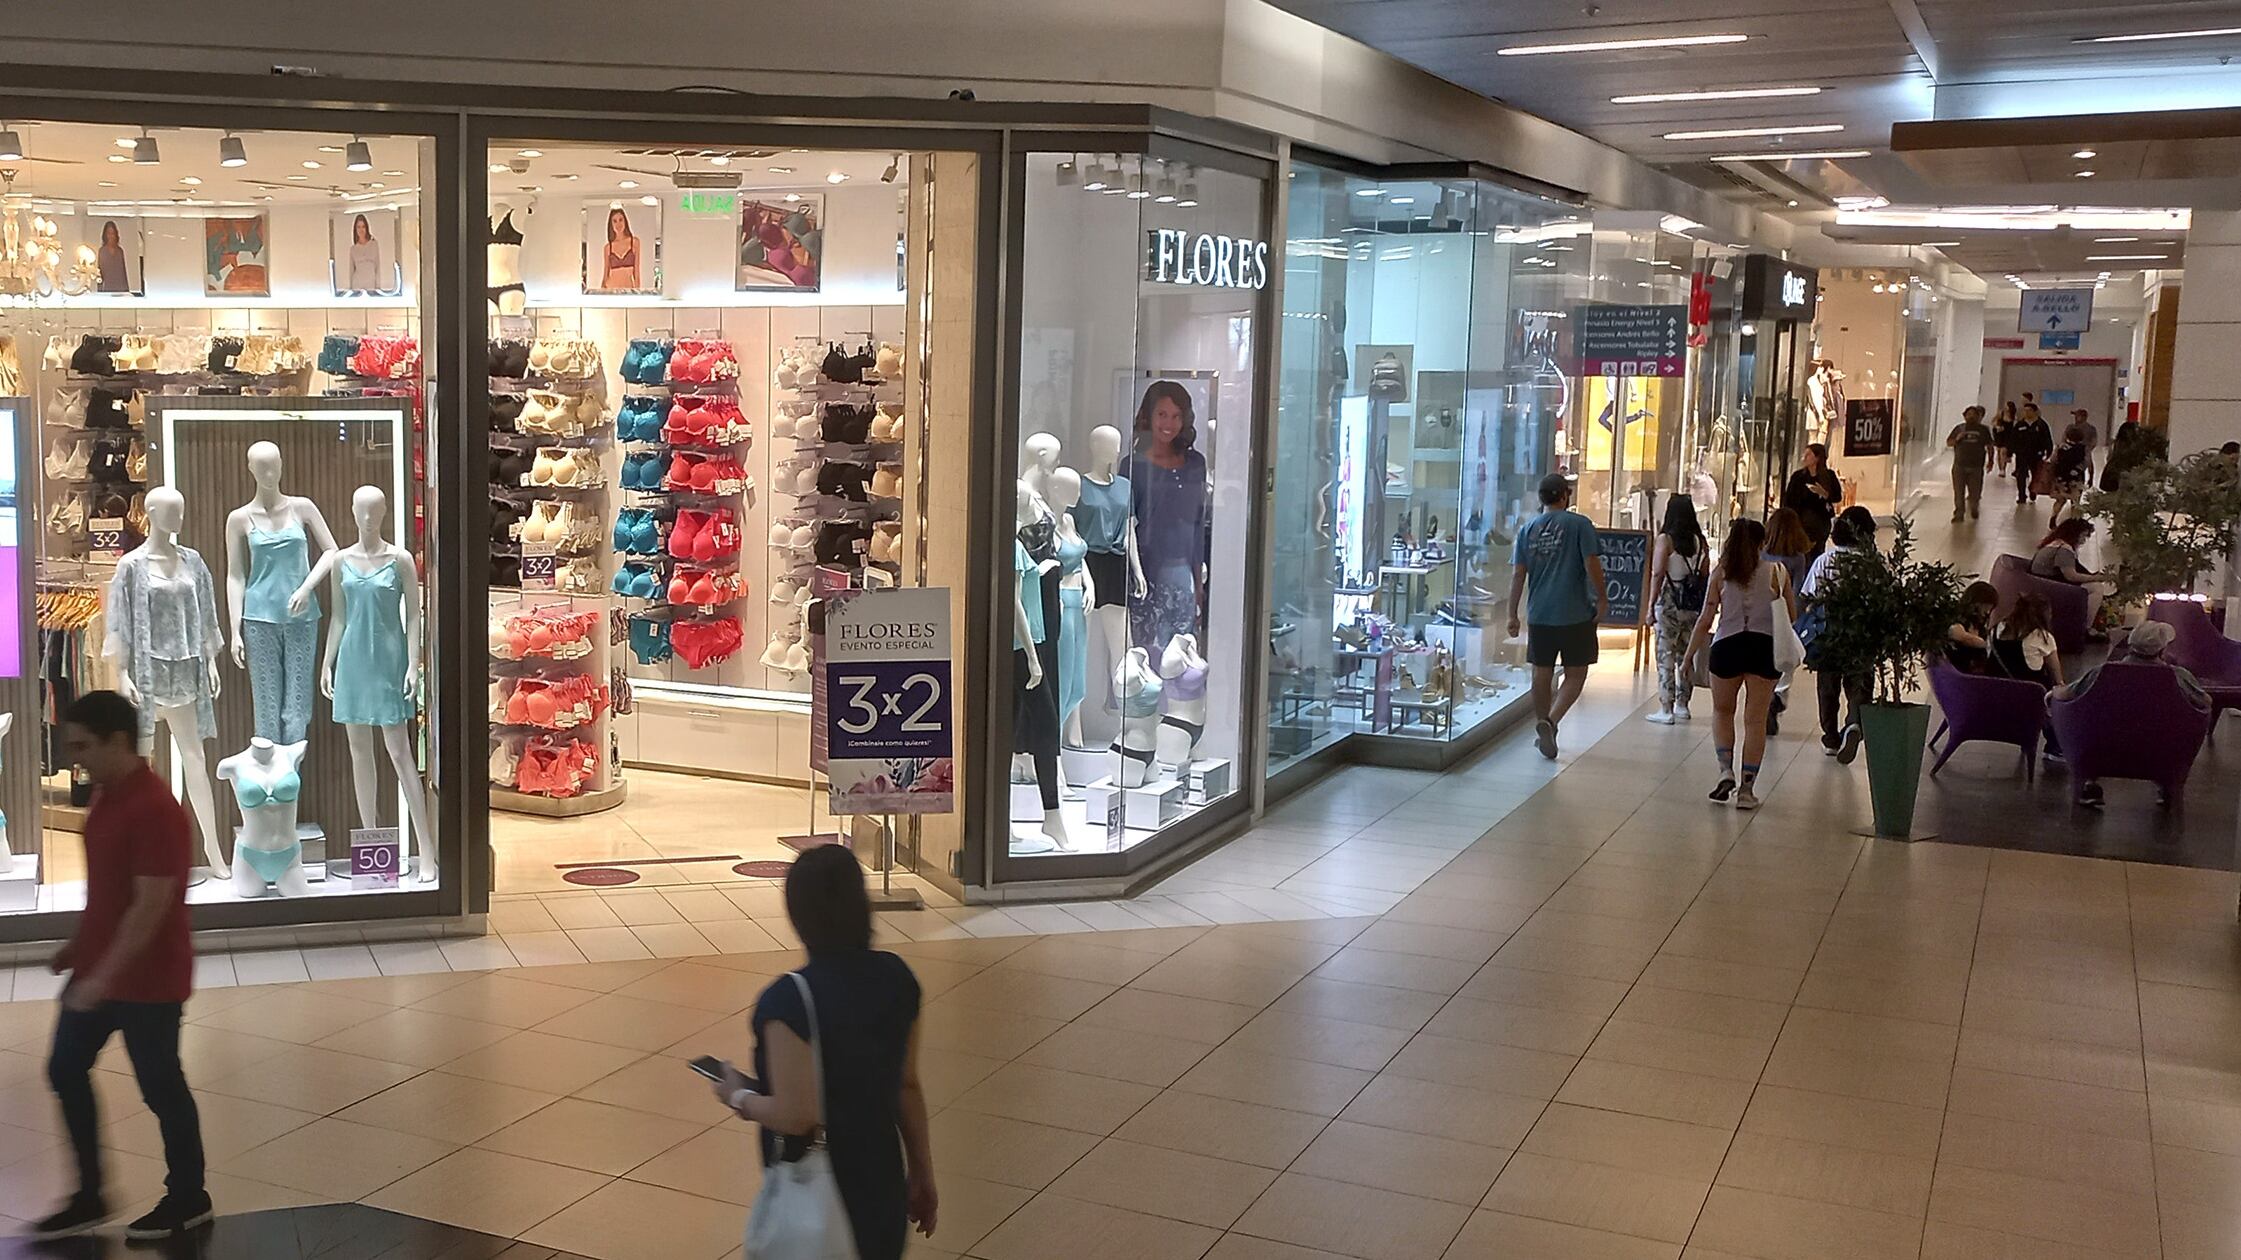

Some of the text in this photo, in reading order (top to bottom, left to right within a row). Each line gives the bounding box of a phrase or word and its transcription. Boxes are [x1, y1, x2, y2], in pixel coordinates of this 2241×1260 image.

[1155, 228, 1268, 290] FLORES
[1637, 350, 1659, 358] Ripley
[93, 531, 121, 548] 3x2
[526, 557, 552, 575] 3x2
[1599, 555, 1643, 573] RIDAY
[841, 622, 936, 640] FLORES
[841, 640, 935, 651] EVENTO ESPECIAL
[837, 673, 942, 734] 3x2
[359, 847, 392, 869] 50
